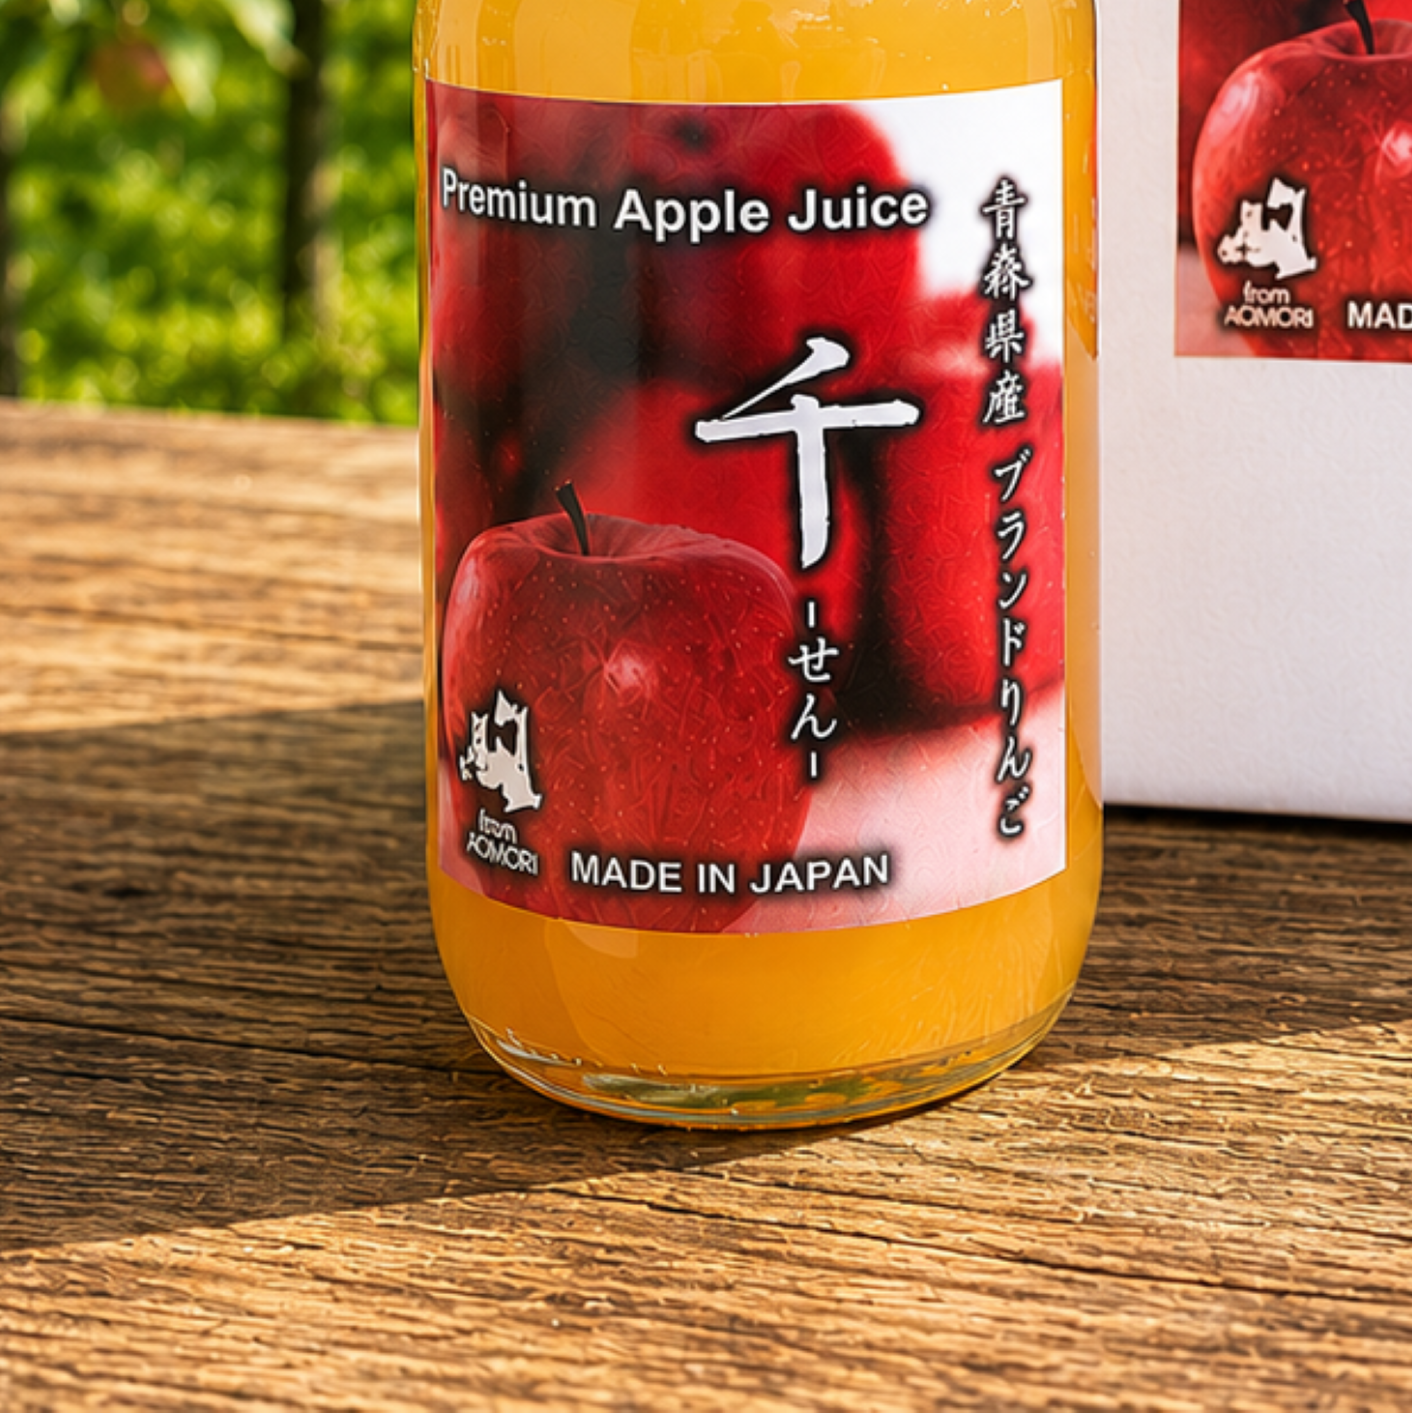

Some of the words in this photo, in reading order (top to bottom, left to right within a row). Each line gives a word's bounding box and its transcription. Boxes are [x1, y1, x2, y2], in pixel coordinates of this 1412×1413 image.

[444, 168, 595, 226] Premium
[615, 190, 768, 242] Apple
[789, 185, 929, 231] Juice
[982, 179, 1031, 424] 青森県産
[1226, 306, 1313, 327] AOMORI
[1244, 276, 1289, 303] from
[696, 338, 919, 567] 千
[995, 448, 1032, 836] ブランドりんご
[467, 832, 538, 876] AOMORI
[573, 853, 681, 891] MADE
[699, 864, 734, 892] IN
[751, 856, 889, 893] JAPAN
